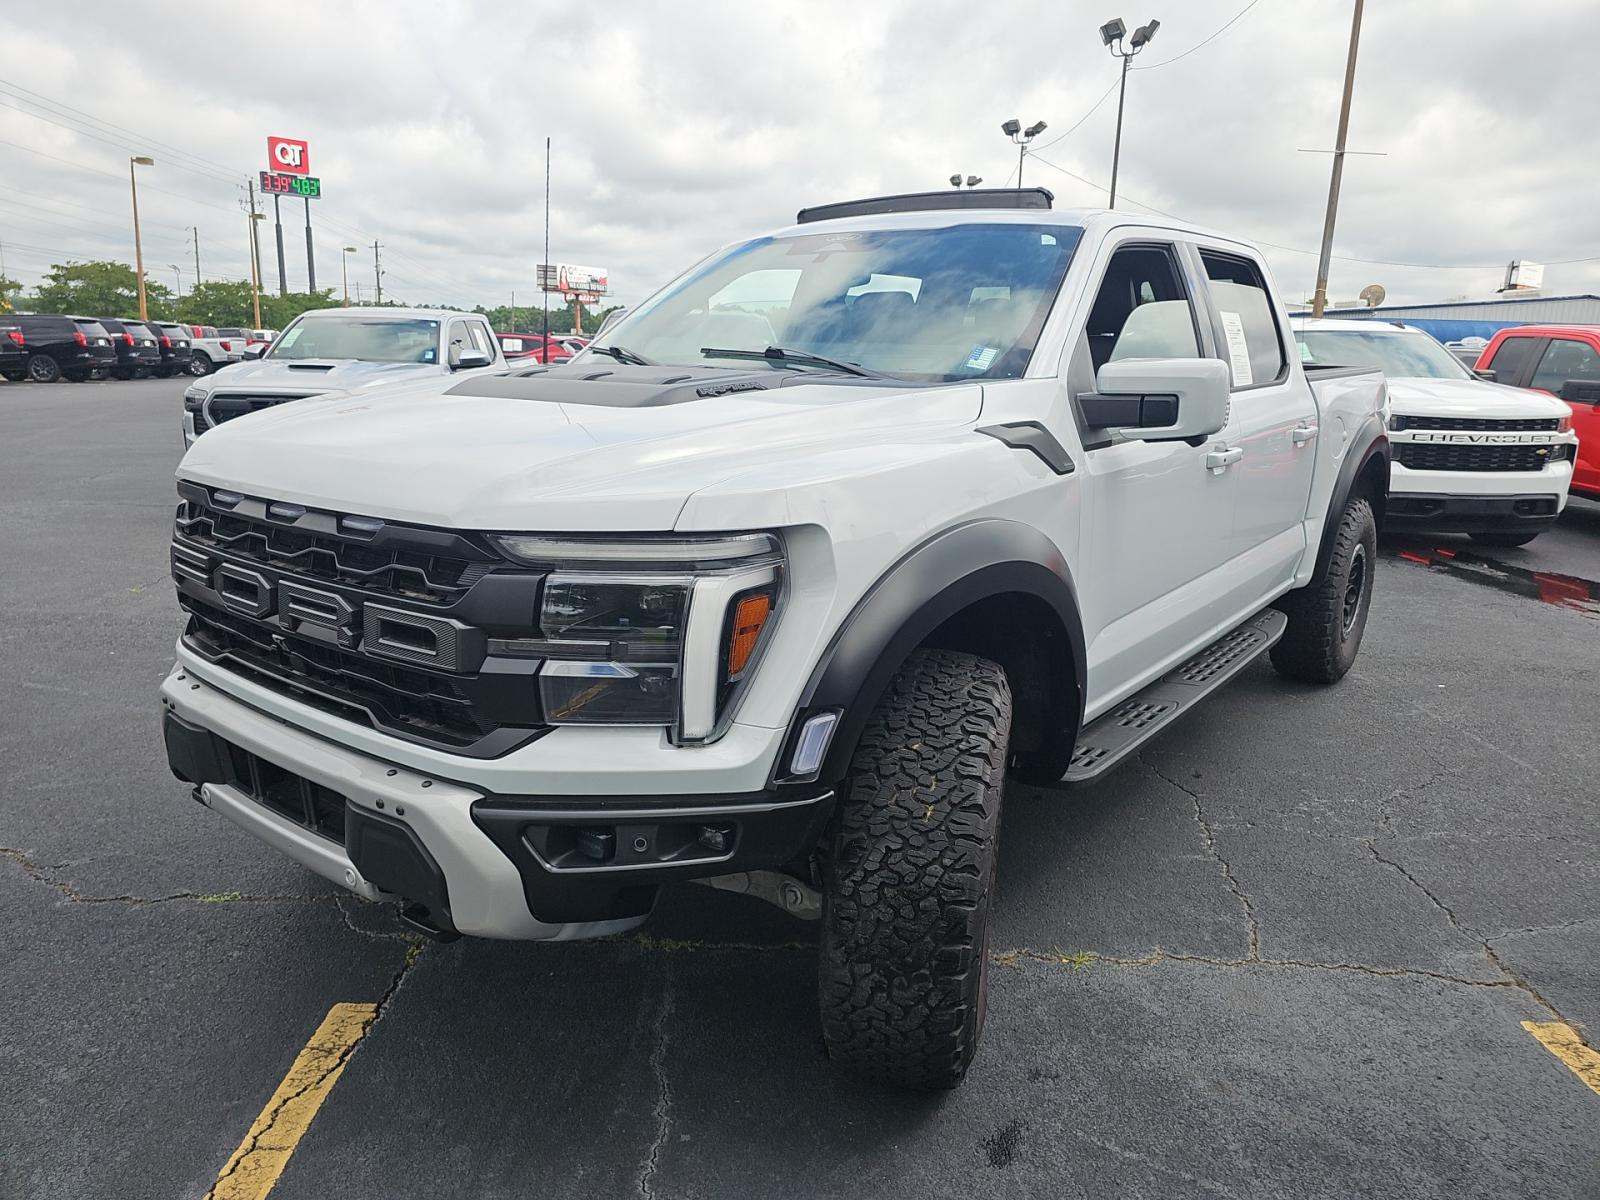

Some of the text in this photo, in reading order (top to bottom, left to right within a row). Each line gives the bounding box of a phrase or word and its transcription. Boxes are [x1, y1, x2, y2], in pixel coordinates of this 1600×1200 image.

[275, 142, 304, 168] QT
[1412, 433, 1553, 443] CHEVROLET
[170, 543, 472, 674] FORD
